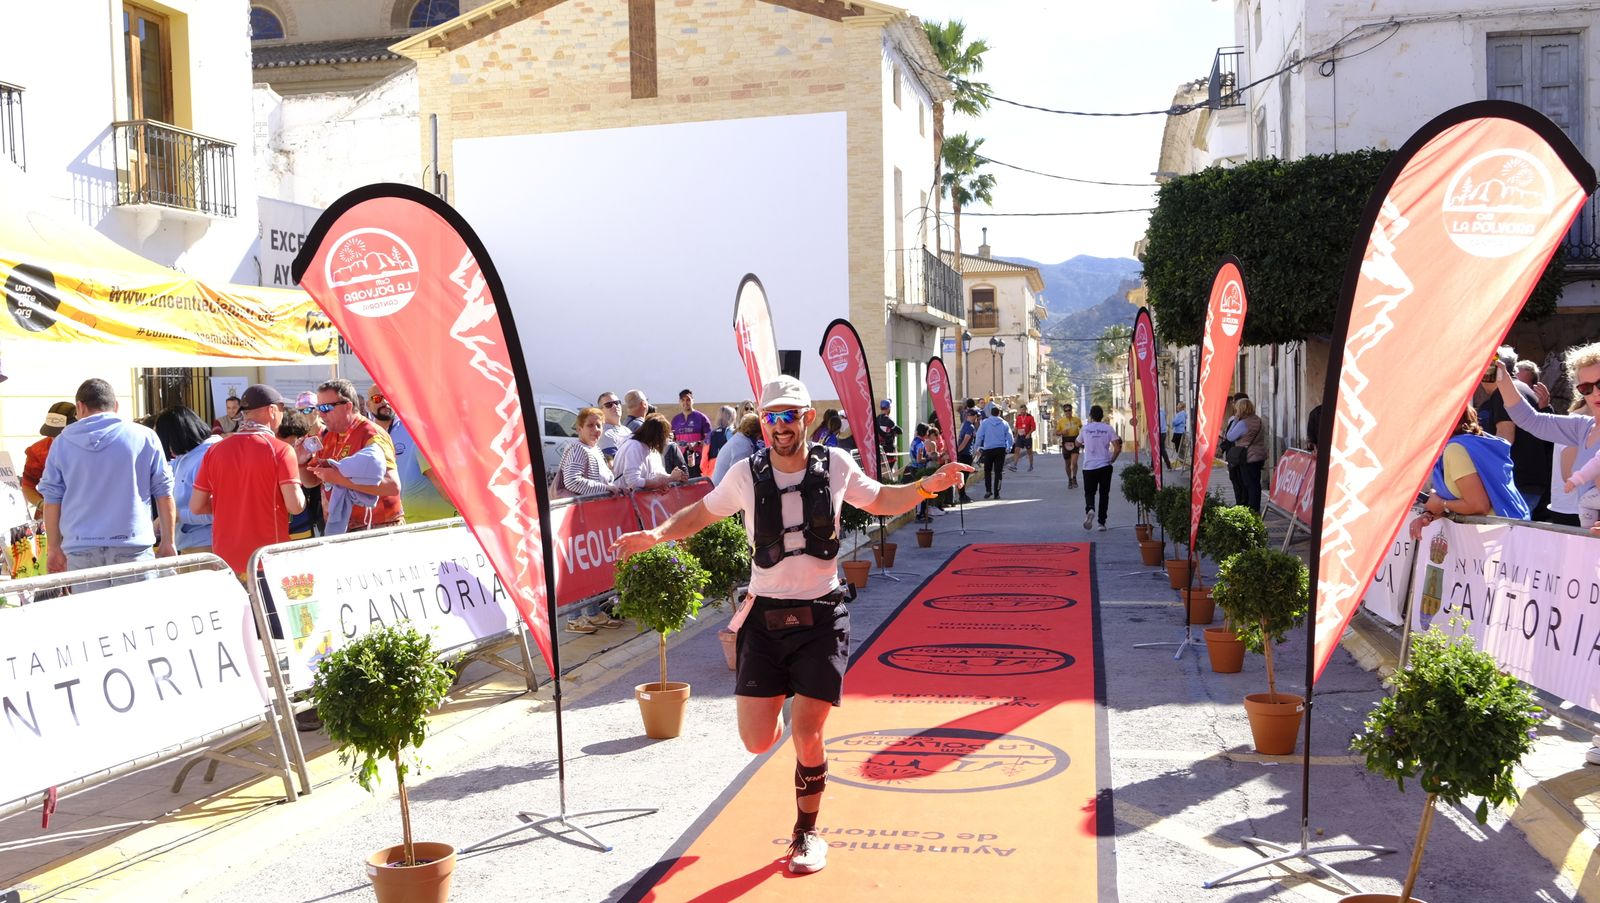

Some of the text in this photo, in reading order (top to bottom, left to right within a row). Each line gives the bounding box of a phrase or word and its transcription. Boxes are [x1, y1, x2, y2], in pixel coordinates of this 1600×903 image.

[1453, 221, 1469, 232] LA
[274, 263, 298, 287] AY
[15, 284, 31, 293] uno
[336, 555, 469, 595] AYUNTAMIENTO
[340, 572, 507, 639] CANTORIA
[191, 610, 223, 636] DE
[873, 699, 1040, 708] Ayuntamiento
[892, 693, 990, 701] Cantoria
[813, 826, 999, 843] de Cantori
[772, 837, 1018, 858] Ayuntamieo
